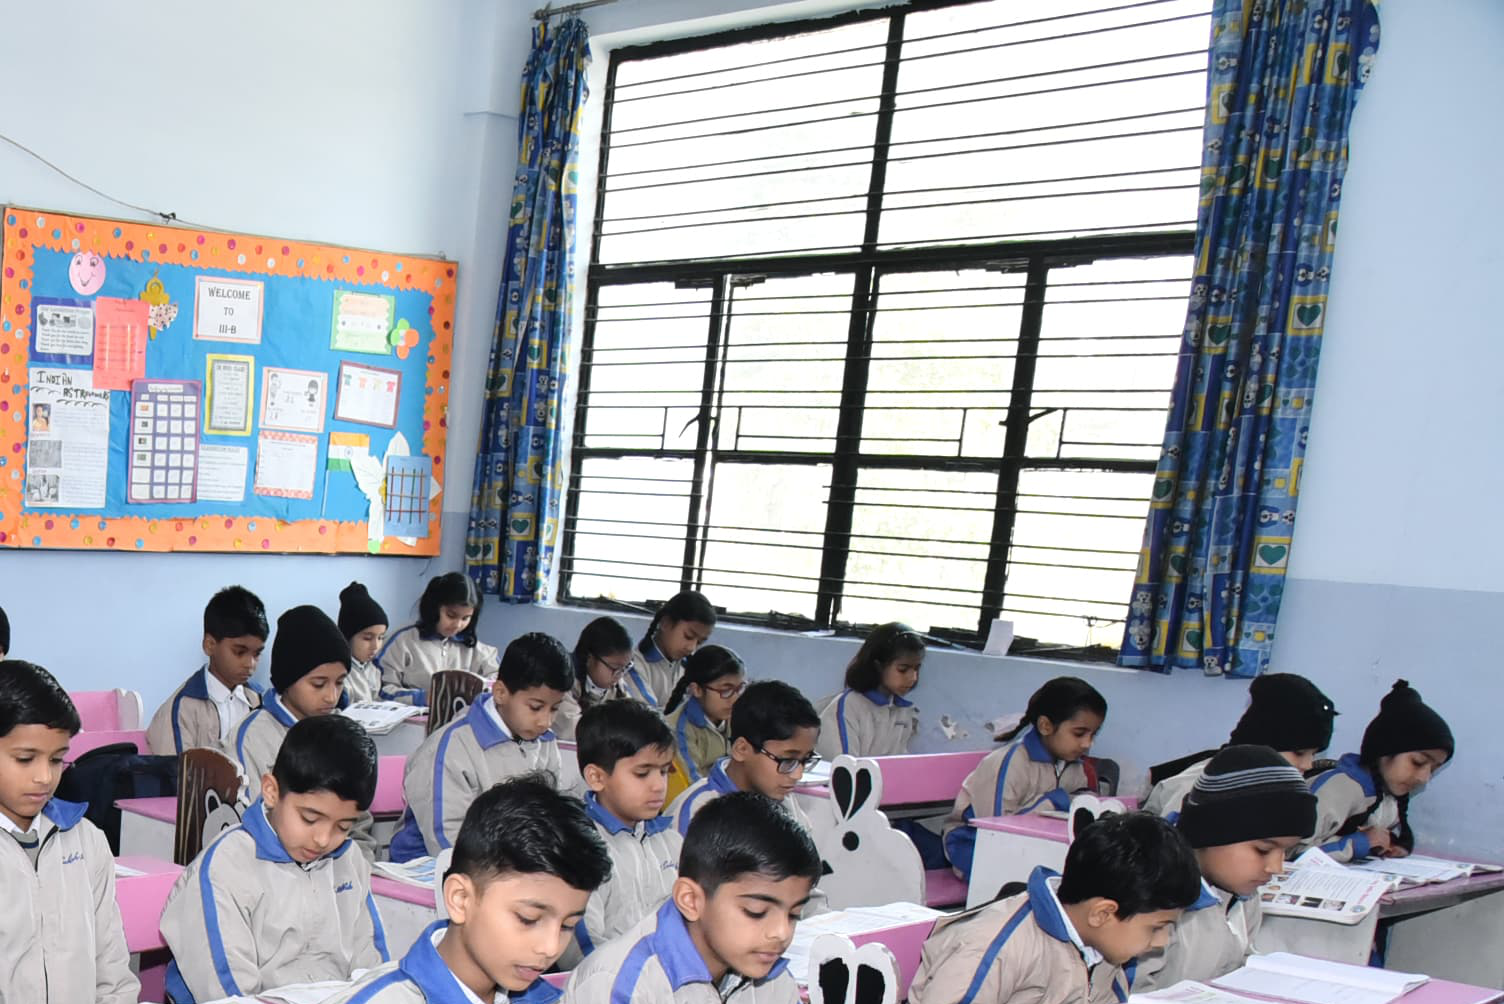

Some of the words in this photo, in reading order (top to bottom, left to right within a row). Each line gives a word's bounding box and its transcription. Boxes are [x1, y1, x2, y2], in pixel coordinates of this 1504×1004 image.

[208, 287, 251, 300] WELCOME
[224, 306, 234, 316] TO
[219, 324, 237, 334] III-B
